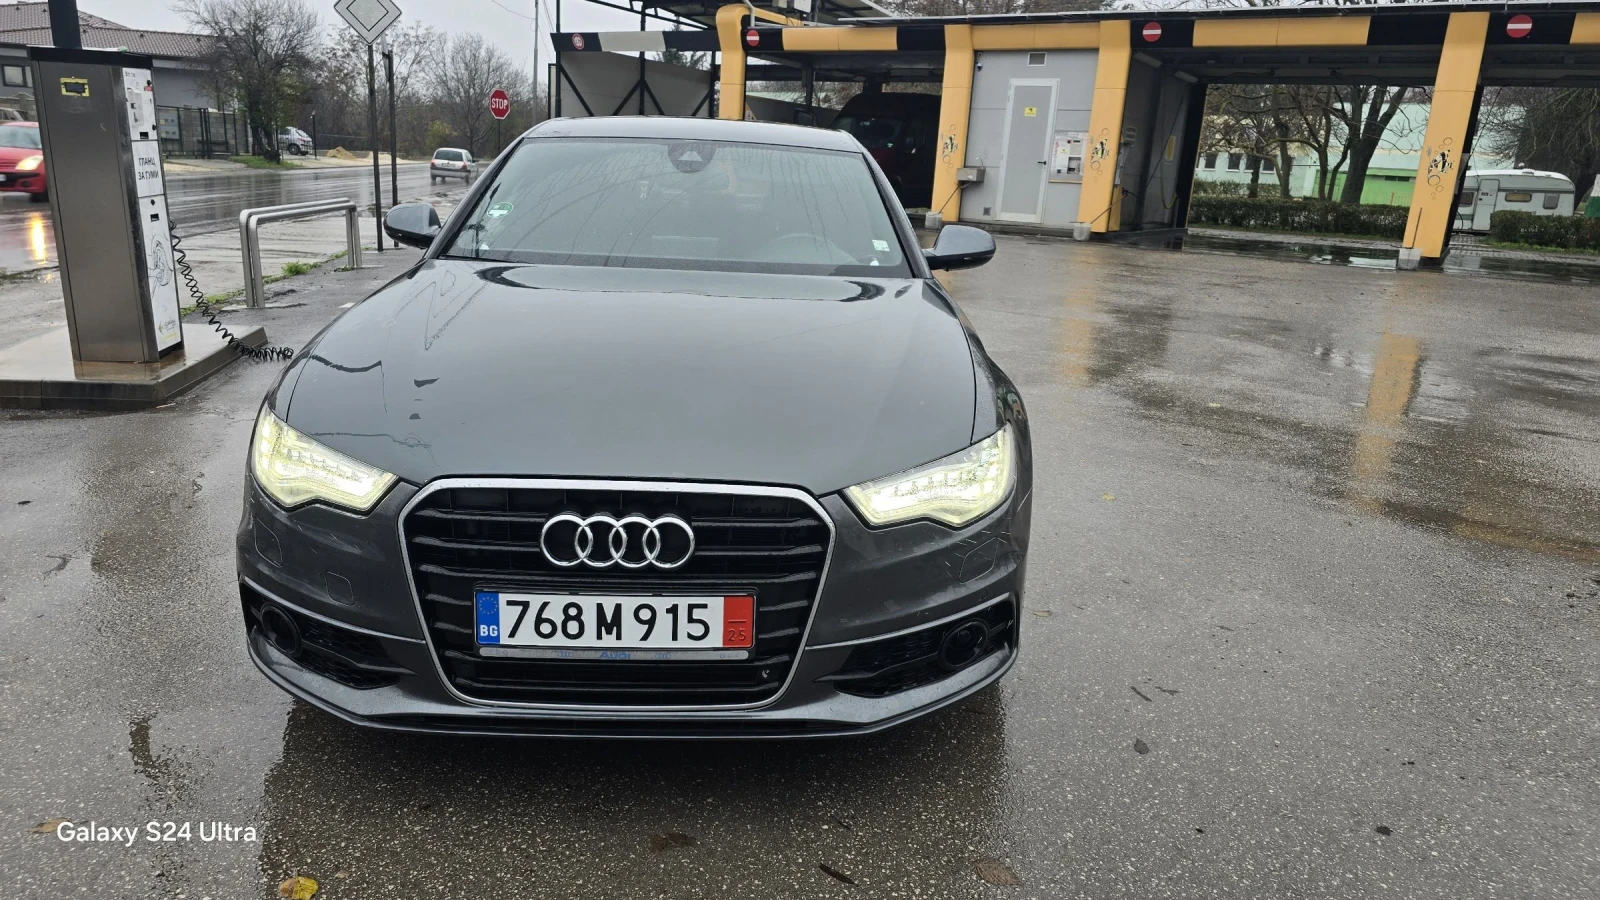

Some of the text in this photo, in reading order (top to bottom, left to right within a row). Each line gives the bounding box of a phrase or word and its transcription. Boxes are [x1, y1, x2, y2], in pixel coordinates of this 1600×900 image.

[491, 98, 508, 109] STOP
[138, 171, 145, 180] ЗА
[480, 624, 498, 637] BG
[727, 628, 746, 642] 25
[600, 651, 631, 660] Audi
